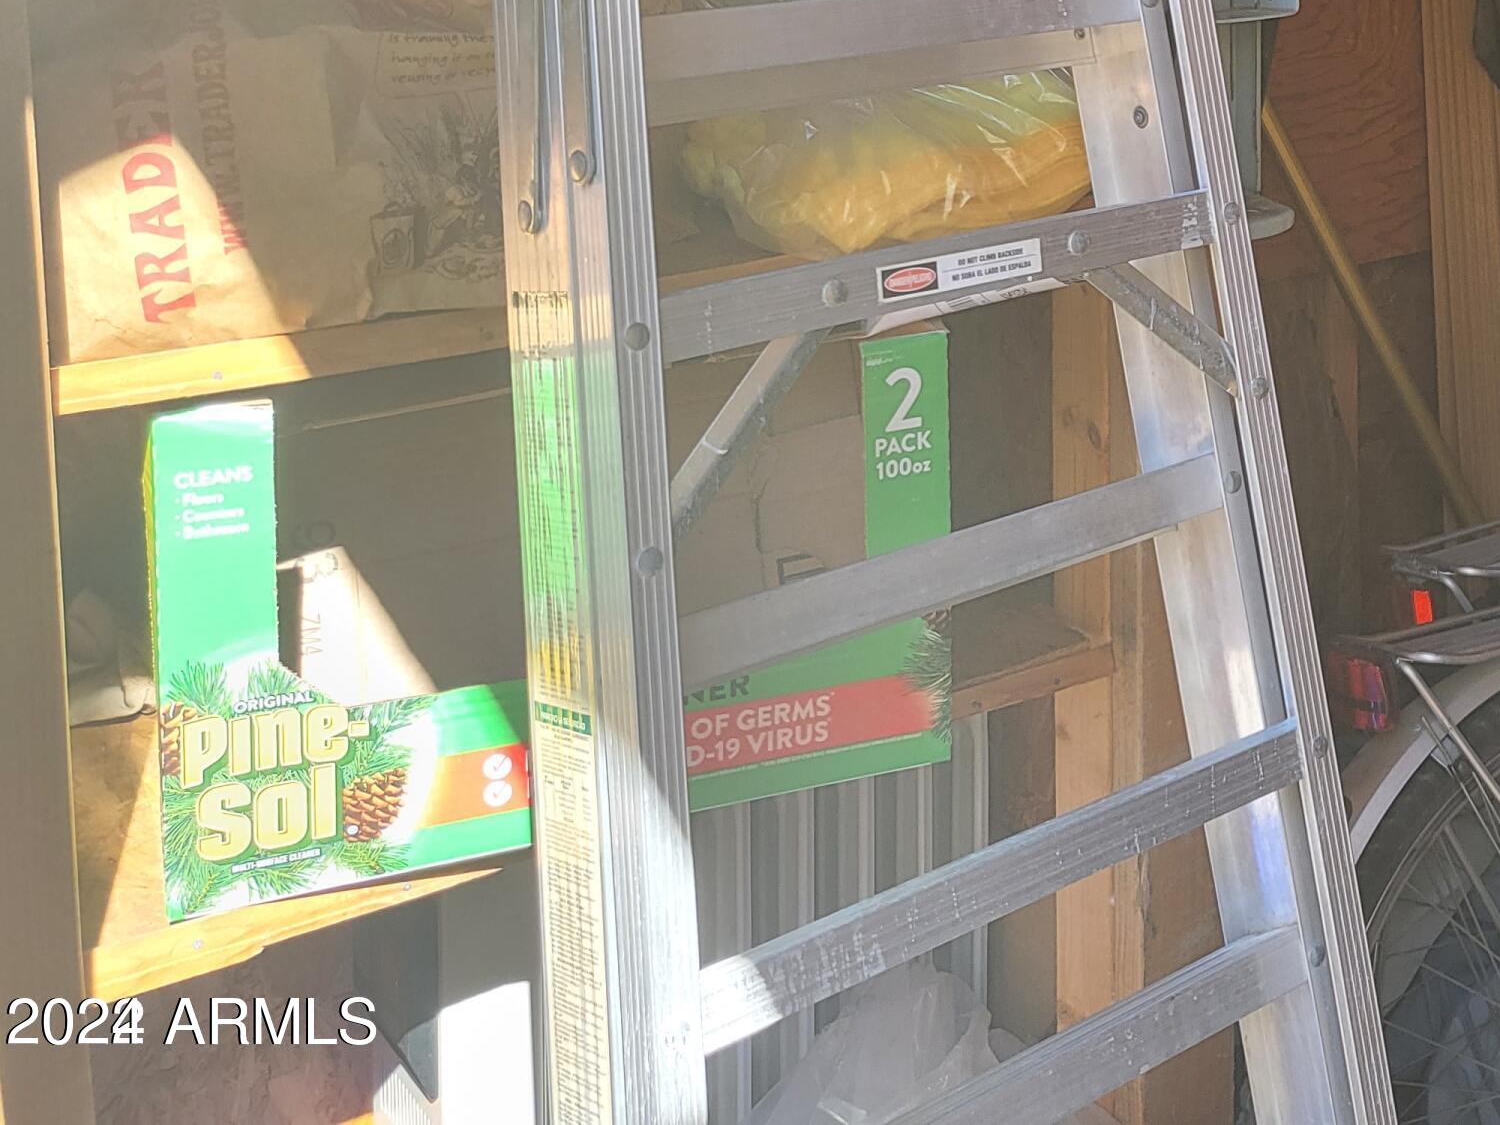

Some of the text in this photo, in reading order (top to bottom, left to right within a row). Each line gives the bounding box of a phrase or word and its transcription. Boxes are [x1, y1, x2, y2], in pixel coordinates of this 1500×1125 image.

[112, 59, 197, 325] TRADER
[885, 366, 923, 433] 2
[875, 430, 932, 458] PACK
[173, 464, 254, 490] CLEANS
[876, 457, 932, 481] 100oz
[233, 690, 315, 714] ORIGINAL
[691, 713, 730, 739] OF
[747, 721, 829, 755] VIRUS
[195, 762, 337, 862] Sol
